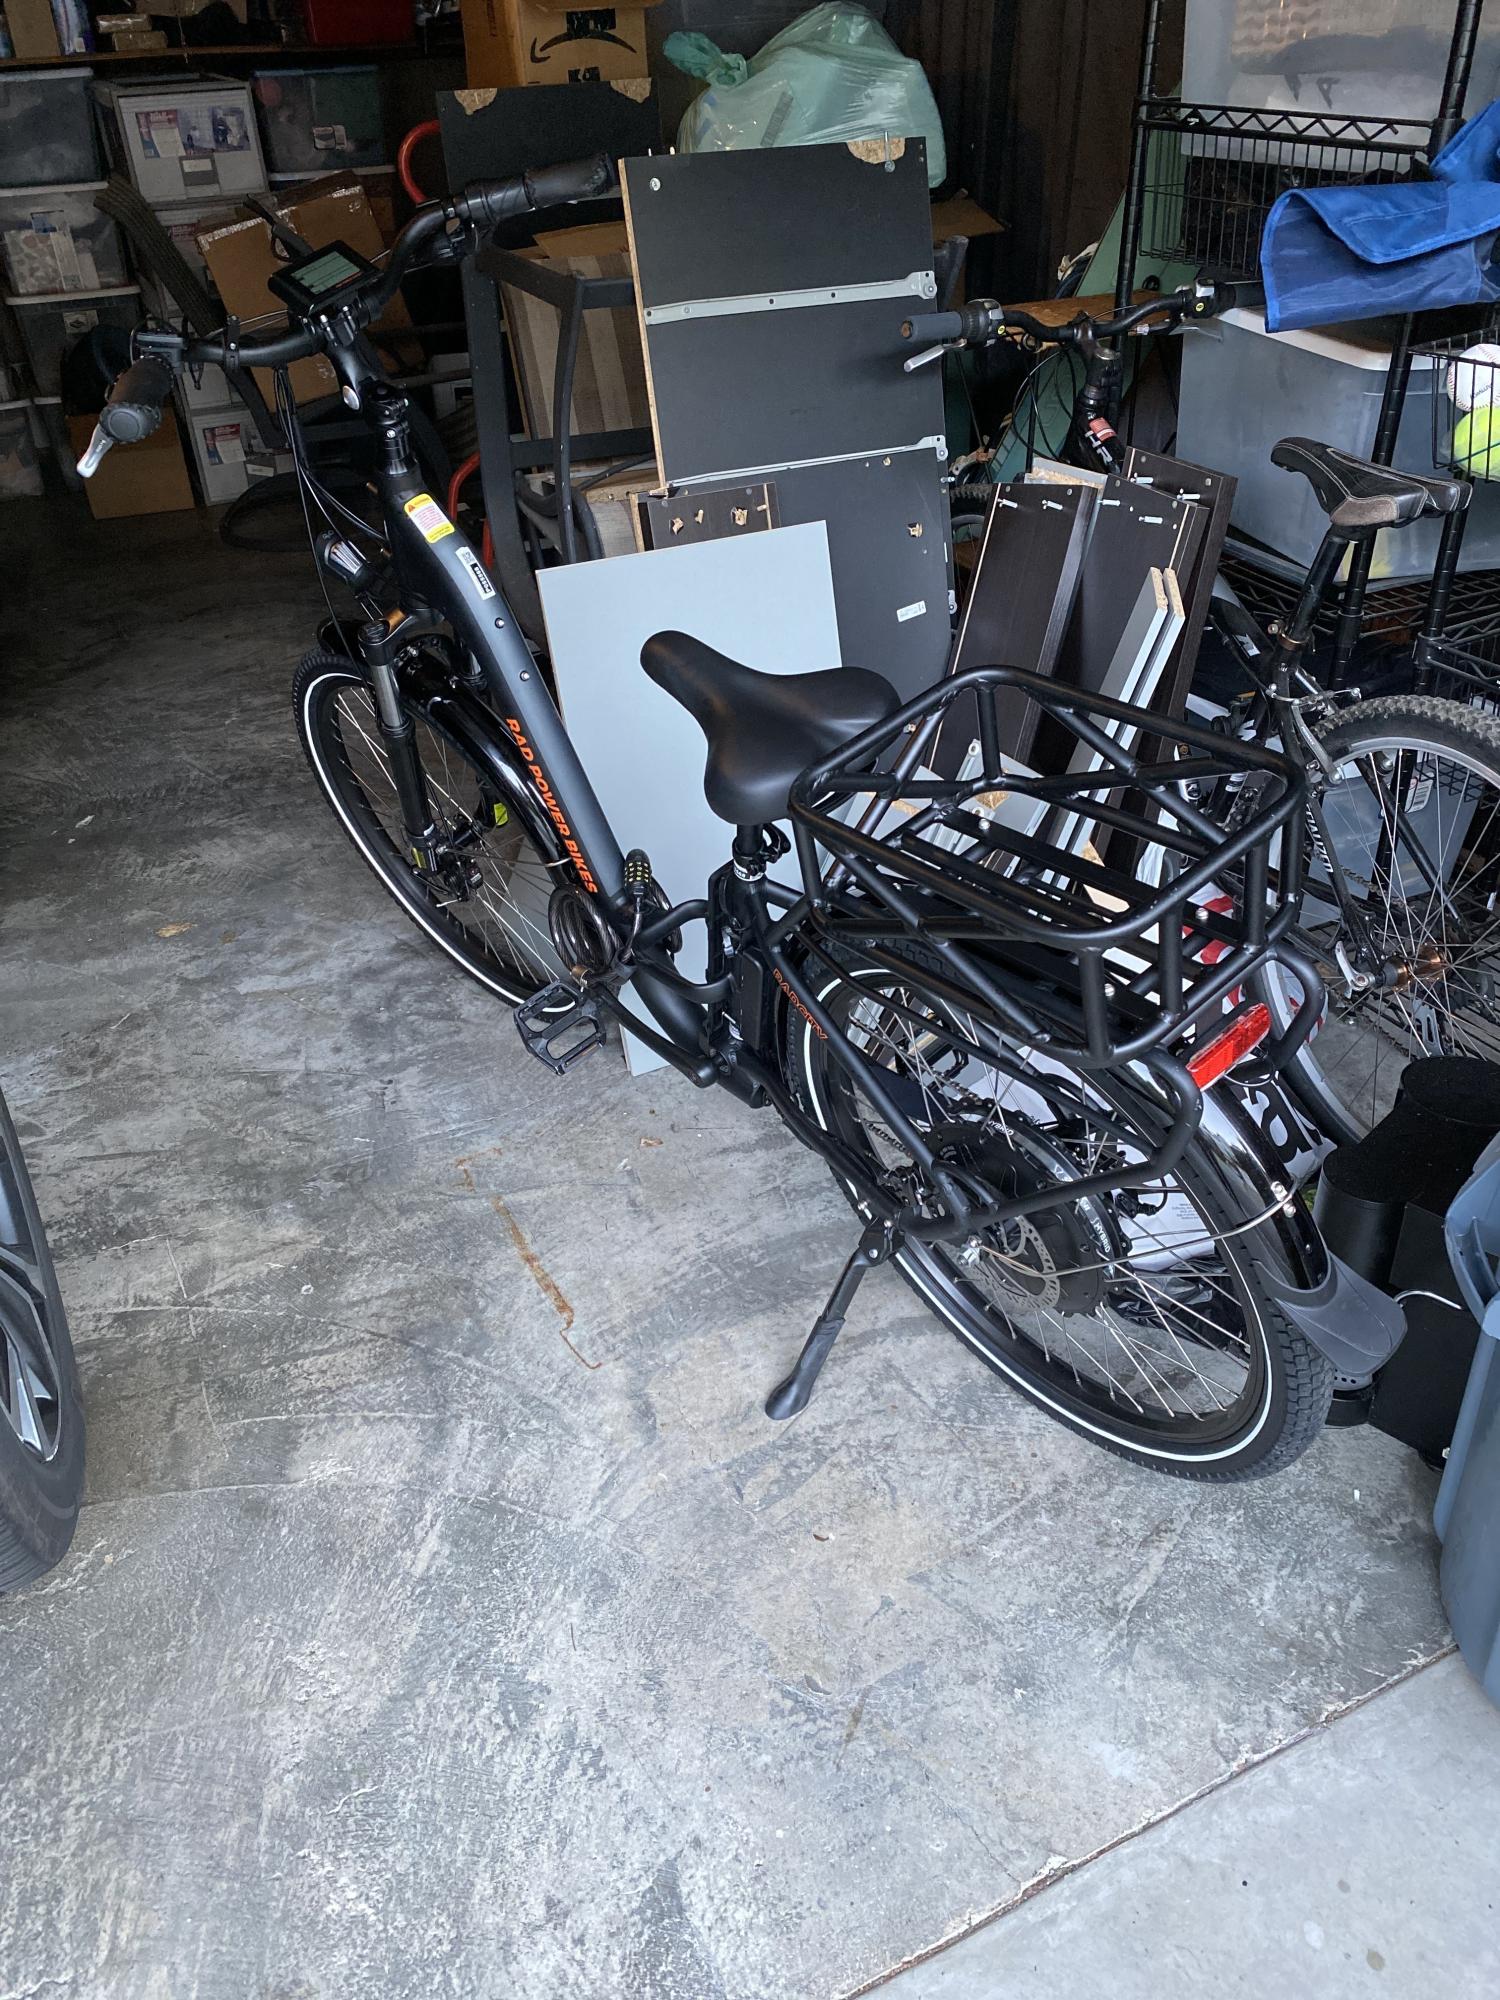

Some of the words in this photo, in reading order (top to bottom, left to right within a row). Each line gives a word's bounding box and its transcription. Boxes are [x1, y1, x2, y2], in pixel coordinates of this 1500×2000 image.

[506, 718, 535, 762] RAD
[528, 764, 571, 836] POWER
[564, 839, 599, 894] BIKES
[772, 967, 829, 1039] RADCITY
